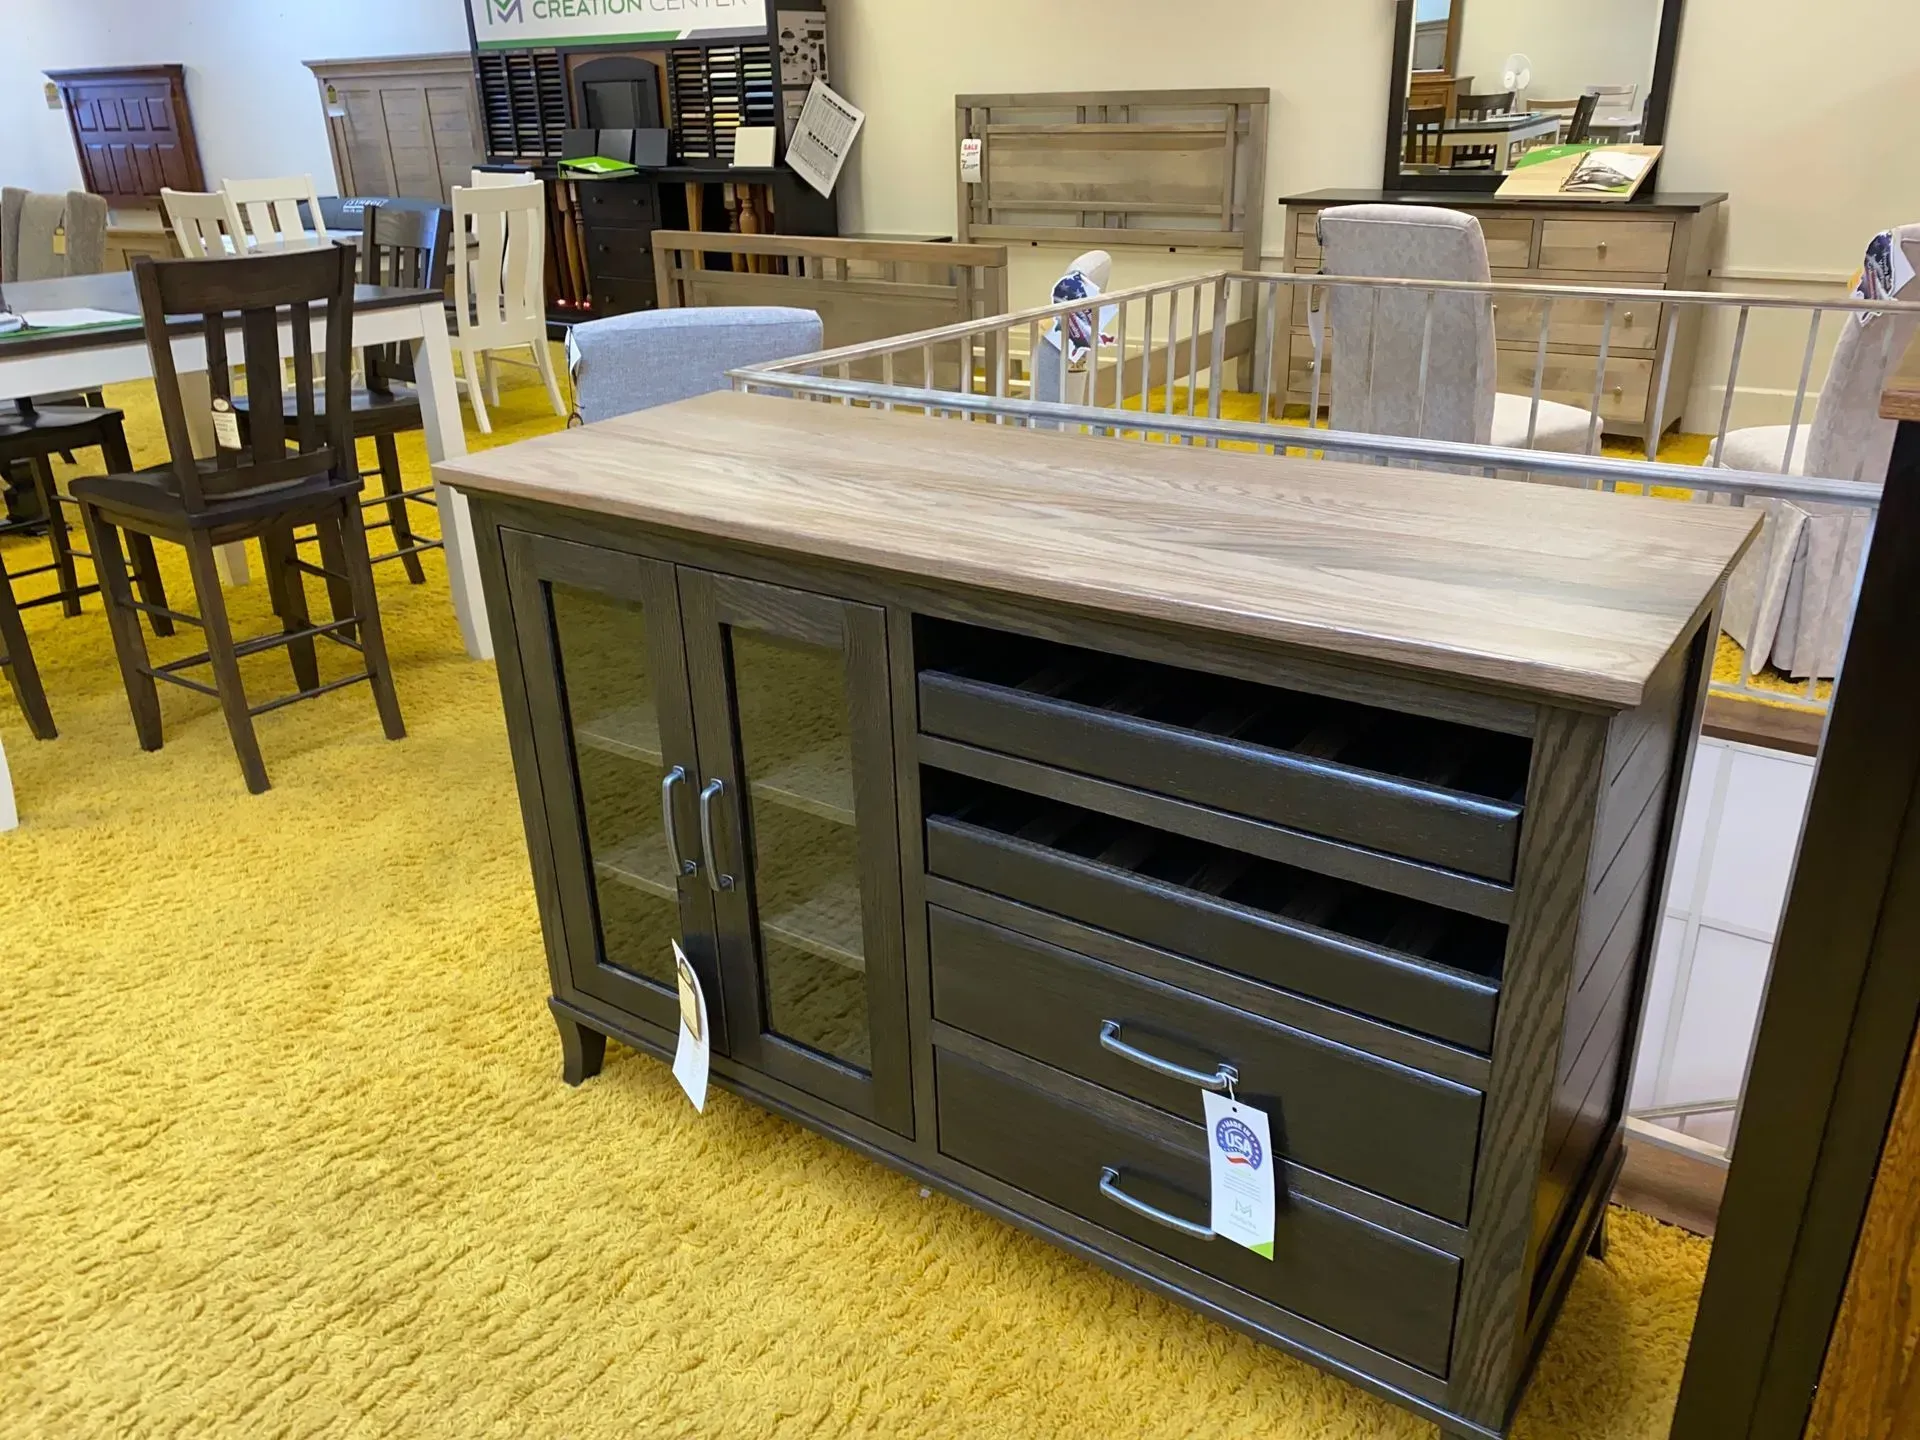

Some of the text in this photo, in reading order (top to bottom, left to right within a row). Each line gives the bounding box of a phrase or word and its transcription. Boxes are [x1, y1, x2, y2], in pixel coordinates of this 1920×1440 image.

[532, 0, 643, 19] CREATION
[1223, 1119, 1243, 1131] MADE
[1224, 1130, 1253, 1154] USA
